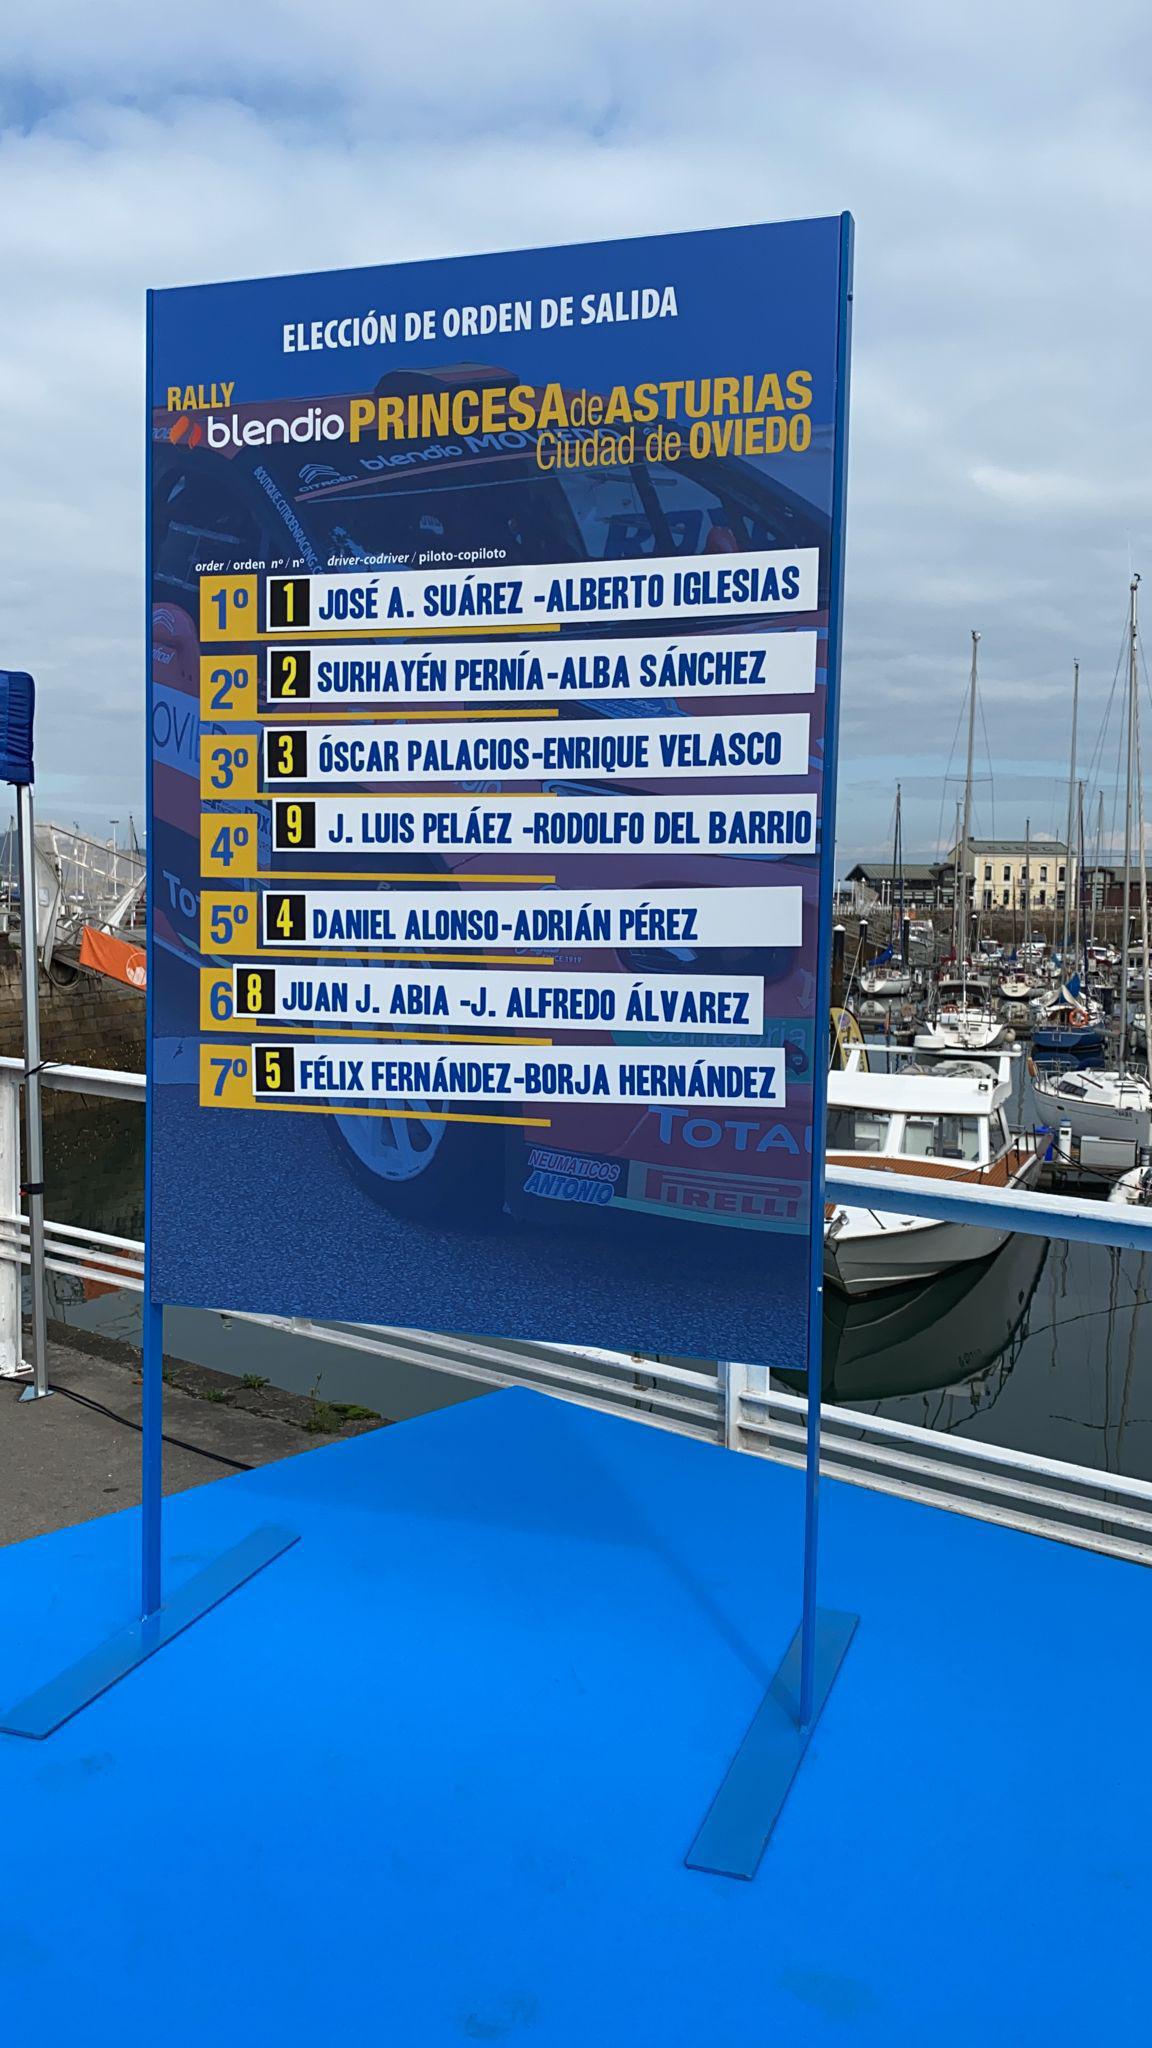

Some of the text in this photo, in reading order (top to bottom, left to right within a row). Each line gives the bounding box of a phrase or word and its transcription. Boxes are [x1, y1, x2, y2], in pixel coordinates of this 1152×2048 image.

[284, 286, 678, 353] ELECCIÓN DE ORDEN DE SALIDA
[167, 381, 235, 412] RALLY
[207, 407, 345, 448] blendio
[536, 413, 812, 471] Ciudad de OVIEDO
[359, 444, 463, 471] blendio
[195, 560, 224, 572] order
[233, 559, 266, 570] orden
[327, 552, 410, 567] driver-codriver
[418, 548, 507, 565] piloto-copiloto
[211, 588, 248, 630] 1º
[282, 582, 294, 623] 1
[318, 578, 379, 620] JOSÉ
[387, 587, 414, 618] A.
[423, 574, 523, 617] SUÁREZ
[673, 566, 800, 607] IGLESIAS
[210, 668, 248, 710] 2º
[281, 655, 297, 696] 2
[317, 652, 447, 693] SURHAYÉN
[640, 645, 767, 688] SÁNCHEZ
[210, 748, 248, 789] 3º
[277, 734, 294, 774] 3
[319, 734, 398, 773] ÓSCAR
[659, 731, 782, 767] VELASCO
[286, 804, 302, 844] 9
[328, 813, 352, 844] J.
[362, 812, 414, 844] LUIS
[423, 806, 512, 844] PELÁEZ
[654, 811, 700, 844] DEL
[708, 810, 812, 844] BARRIO
[210, 826, 248, 867] 4º
[162, 869, 200, 918] TO
[210, 904, 248, 944] 5º
[276, 898, 294, 938] 4
[312, 909, 396, 940] DANIEL
[620, 902, 698, 941] PÉREZ
[210, 982, 233, 1021] 6
[246, 973, 262, 1012] 8
[282, 982, 348, 1013] JUAN
[356, 984, 380, 1014] J.
[390, 984, 449, 1016] ABIA
[506, 986, 616, 1022] ALFREDO
[625, 982, 750, 1025] ÁLVAREZ
[210, 1058, 248, 1096] 7º
[265, 1051, 281, 1090] 5
[300, 1055, 364, 1091] FÉLIX
[619, 1059, 776, 1099] HERNÁNDEZ
[648, 1104, 812, 1155] TOTA
[528, 1149, 621, 1182] NEUMATICOS
[523, 1170, 615, 1206] ANTONIO
[644, 1167, 803, 1219] PIRELLI
